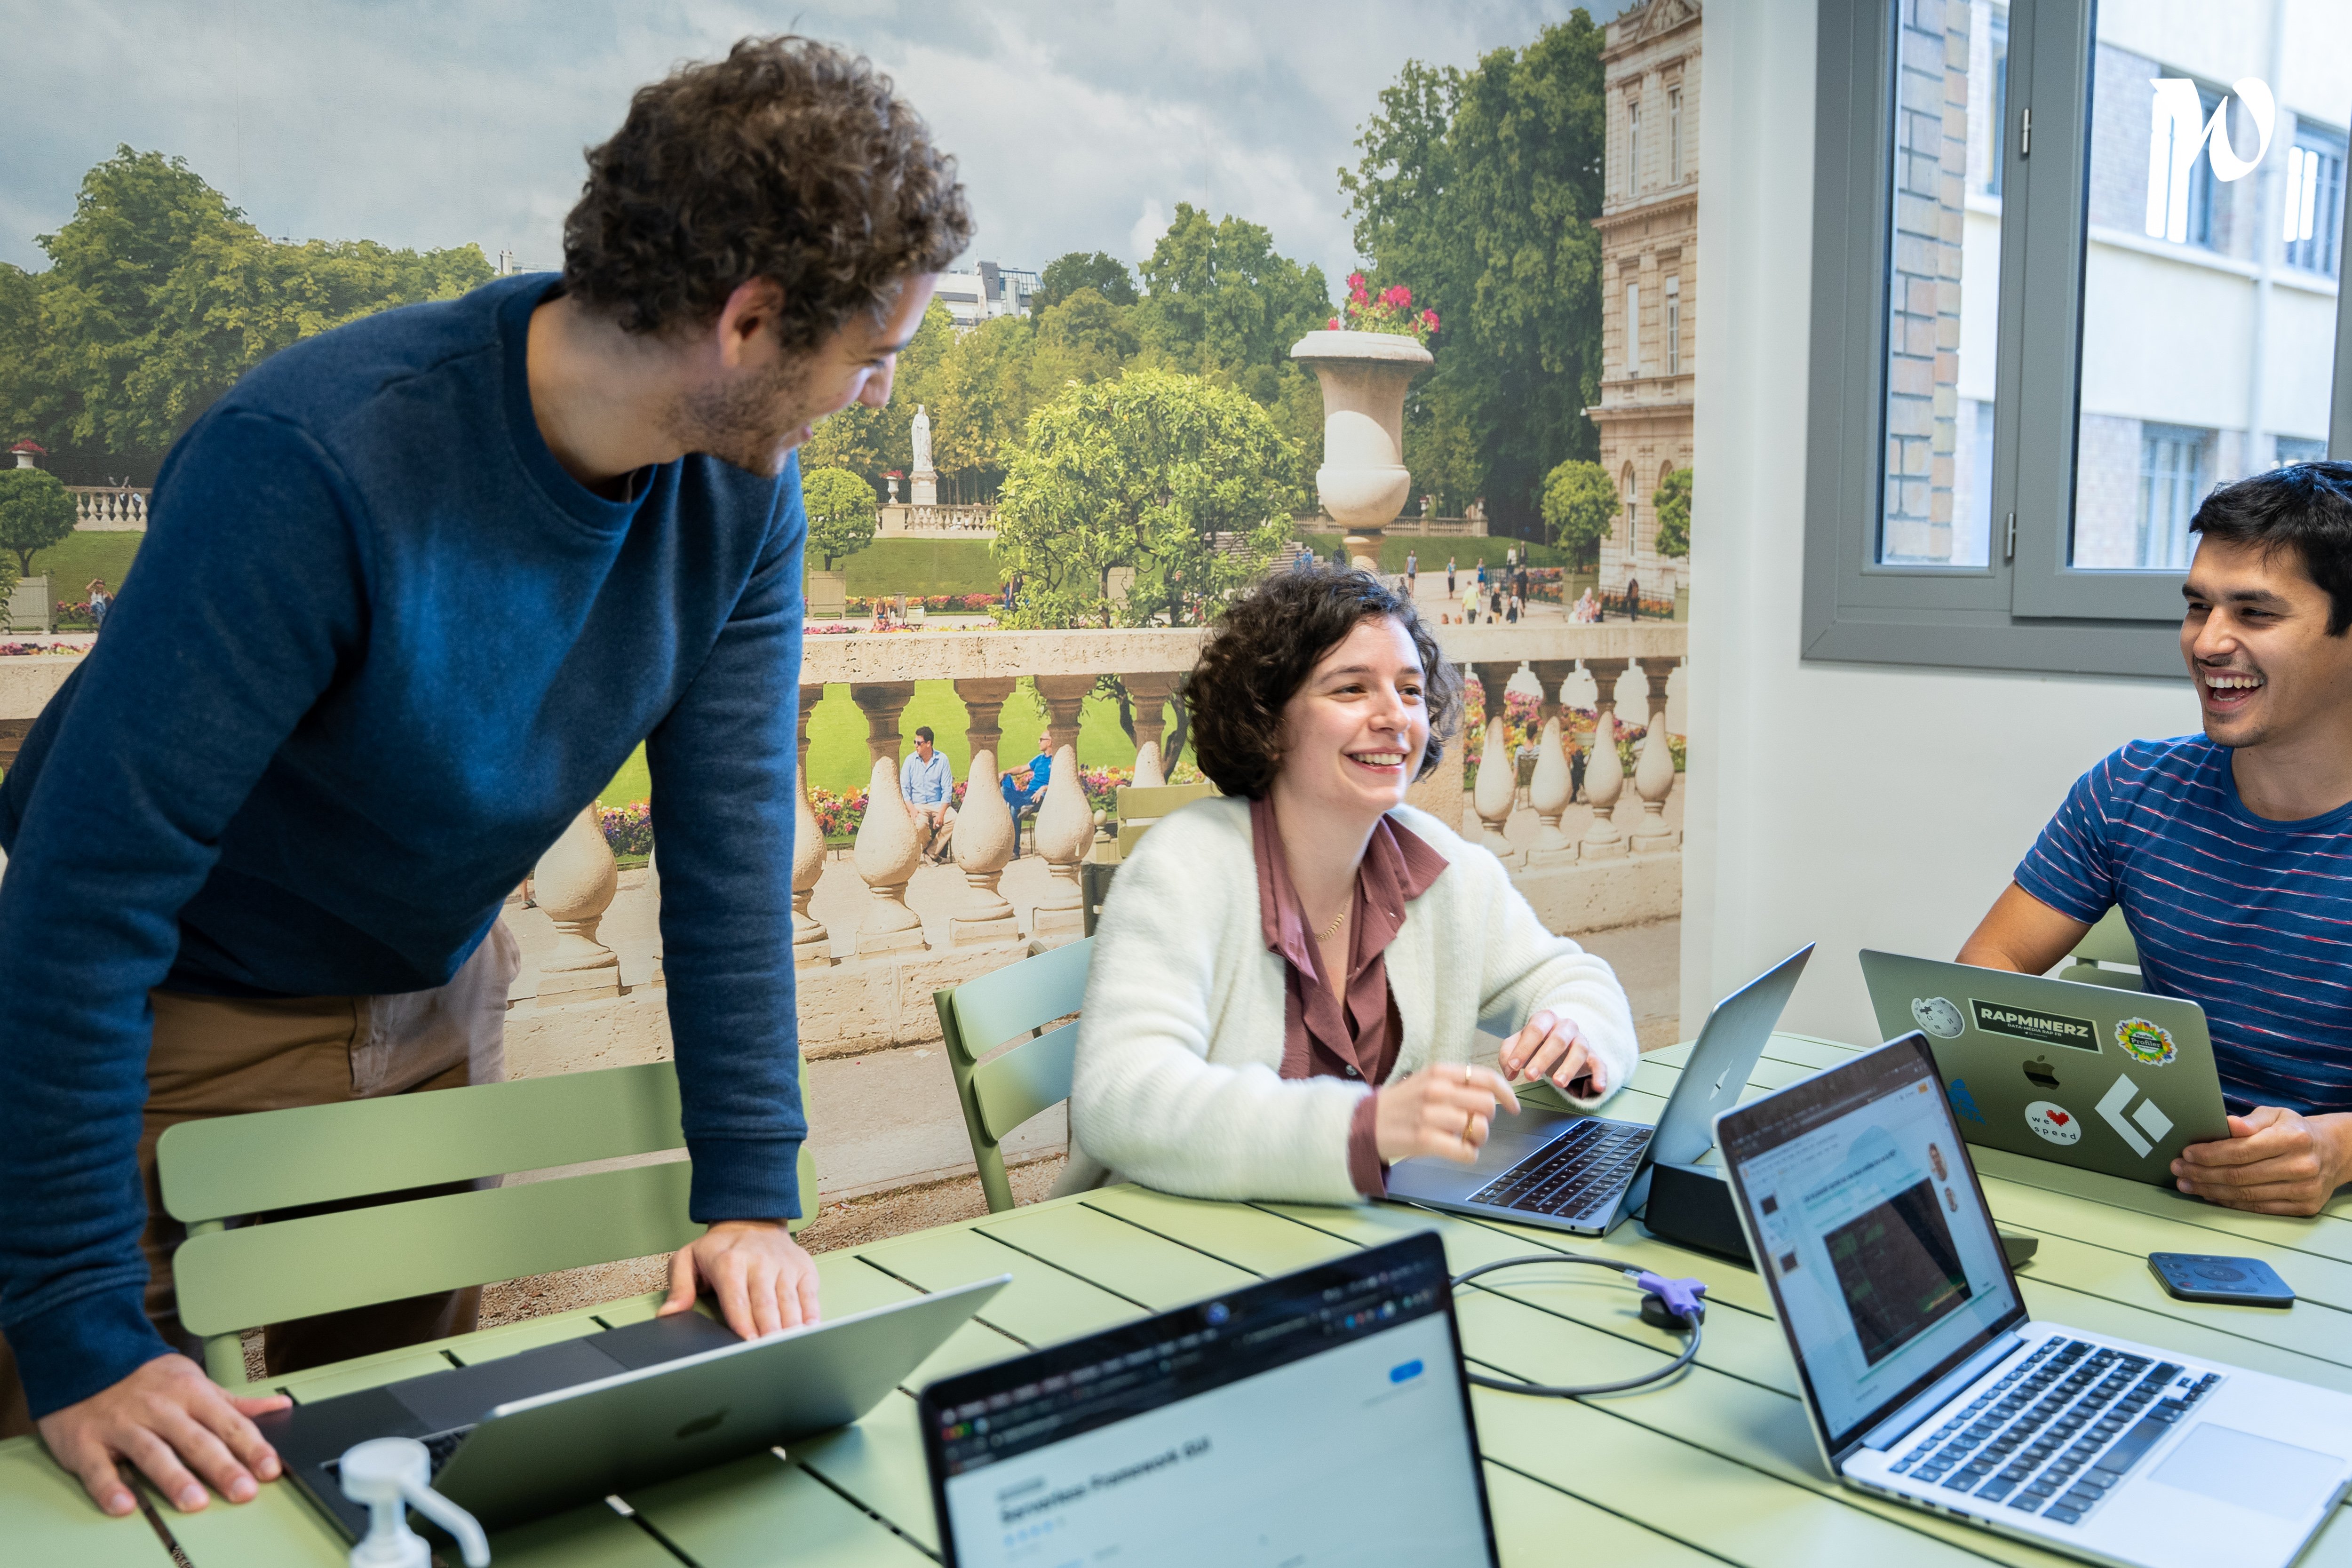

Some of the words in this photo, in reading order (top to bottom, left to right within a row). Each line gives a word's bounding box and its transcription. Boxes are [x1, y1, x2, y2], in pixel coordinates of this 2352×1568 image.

[1981, 1008, 2089, 1037] RAPMINERZ
[2130, 1037, 2161, 1048] Profiler
[2034, 1127, 2076, 1140] speed
